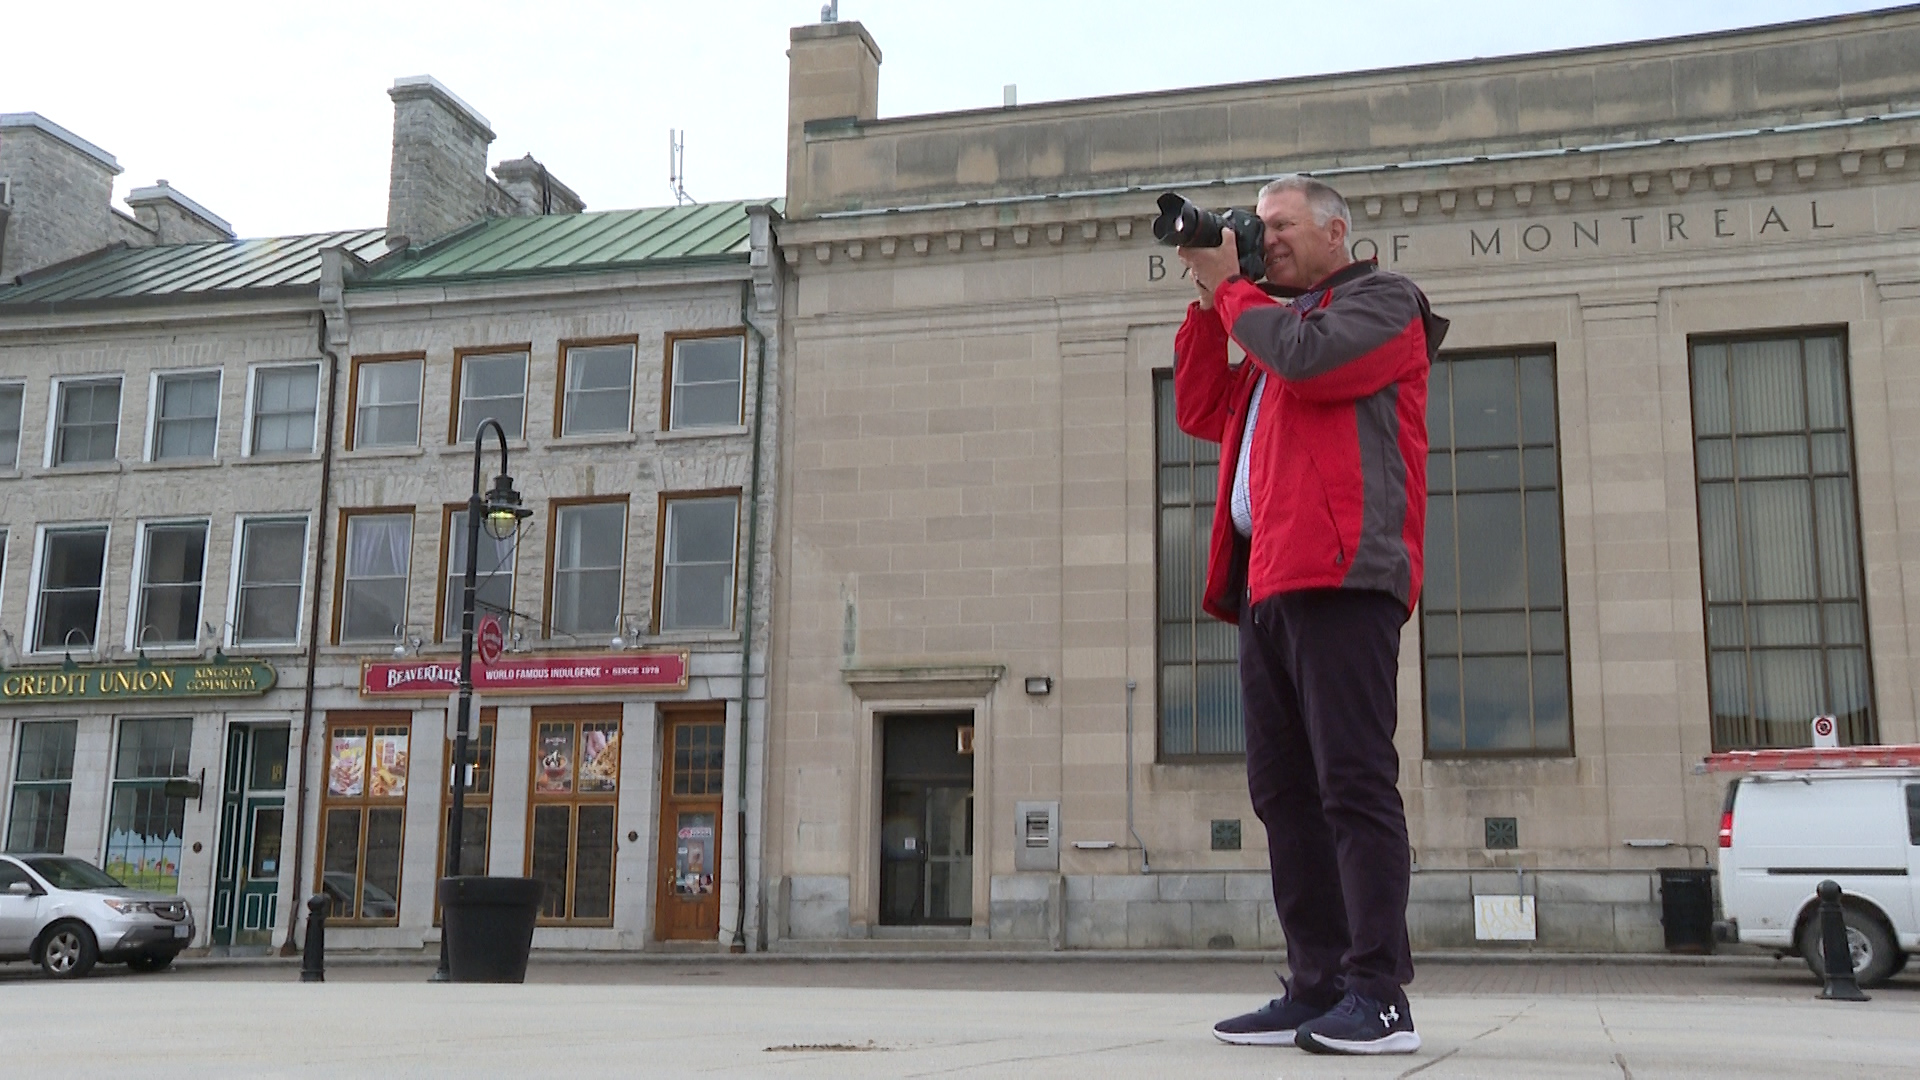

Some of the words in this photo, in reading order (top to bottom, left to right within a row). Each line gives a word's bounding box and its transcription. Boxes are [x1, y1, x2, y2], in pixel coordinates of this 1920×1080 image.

[1351, 234, 1410, 263] OF
[1469, 201, 1835, 256] MONTREAL
[194, 666, 252, 678] KINGSTON
[485, 669, 515, 680] WORLD
[515, 668, 549, 680] FAMOUS
[550, 666, 602, 678] INDULGENCE
[3, 672, 92, 697] CREDIT
[99, 669, 176, 693] UNION
[186, 679, 258, 691] COMMUNITY
